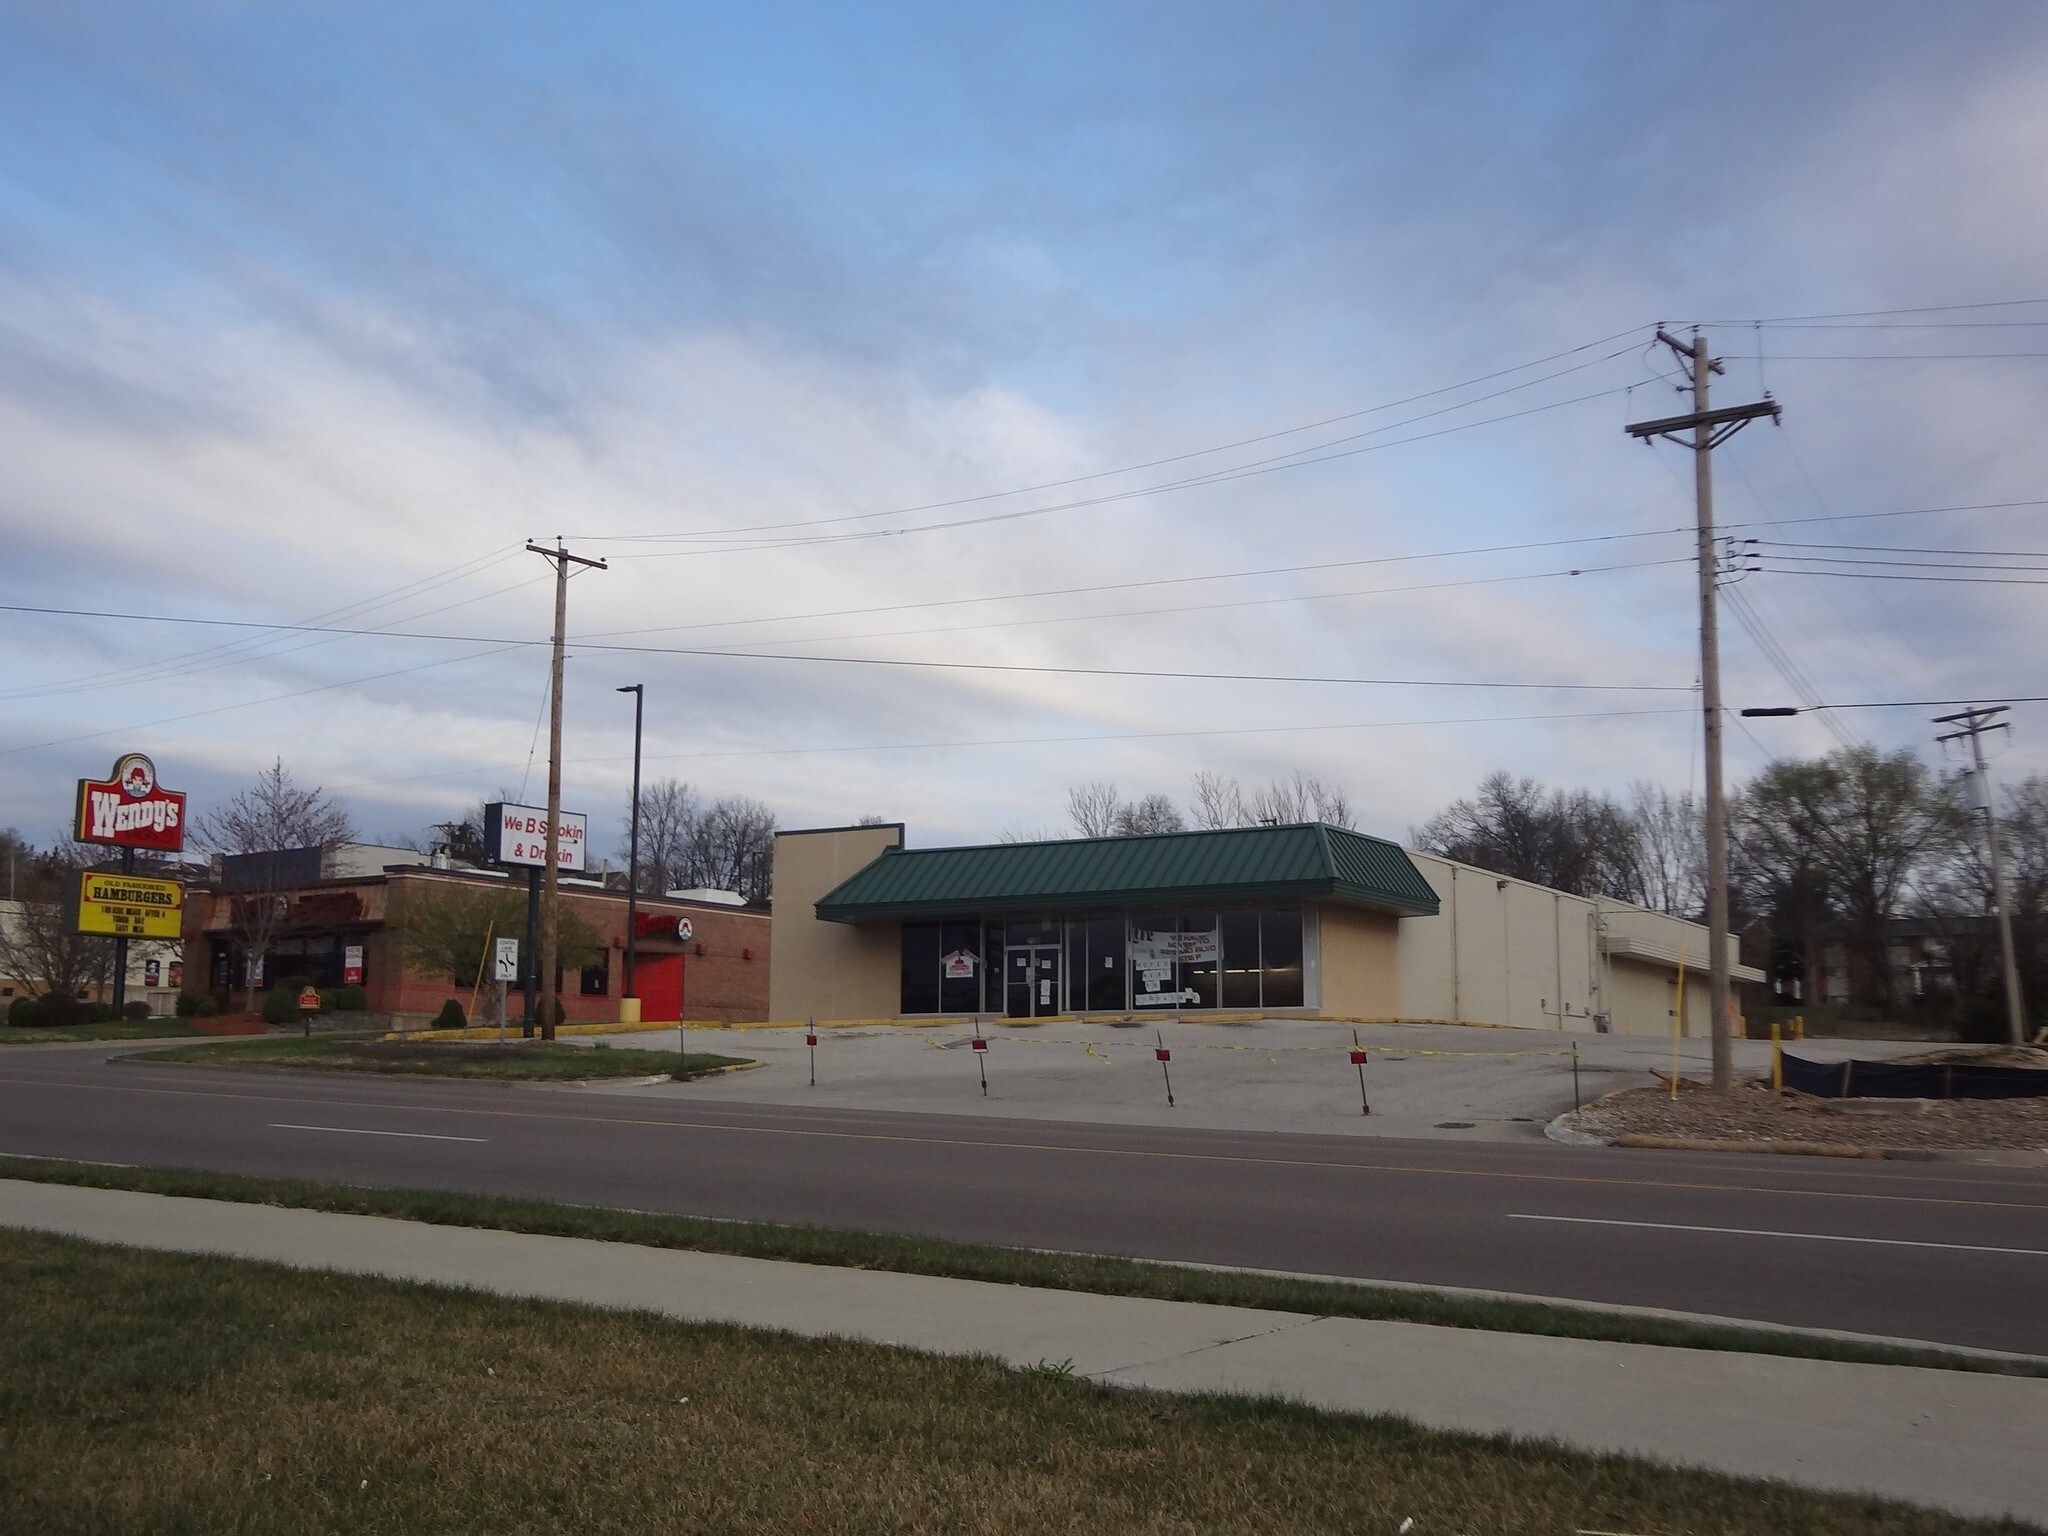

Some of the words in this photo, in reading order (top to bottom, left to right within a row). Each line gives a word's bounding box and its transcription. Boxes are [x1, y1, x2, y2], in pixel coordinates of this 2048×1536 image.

[504, 815, 523, 831] We
[525, 817, 537, 833] B
[538, 820, 583, 839] Sokin
[514, 842, 524, 857] &
[529, 845, 573, 863] Drkin
[93, 886, 172, 905] HAMBURGERS
[122, 881, 167, 892] FASHIONED
